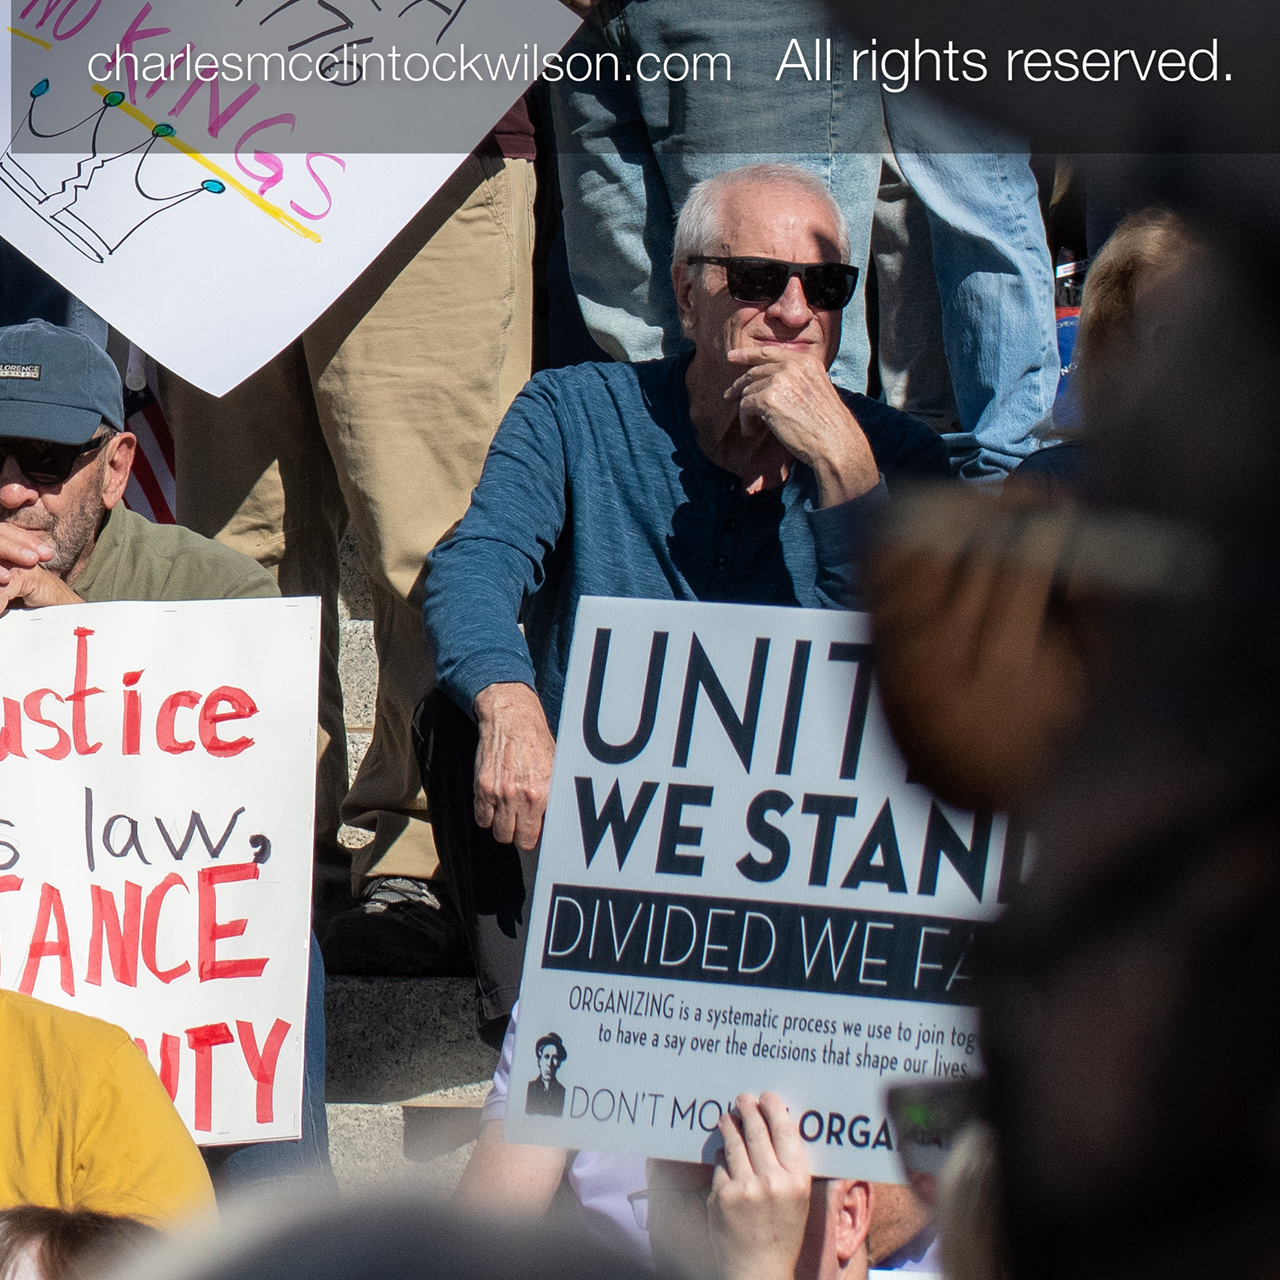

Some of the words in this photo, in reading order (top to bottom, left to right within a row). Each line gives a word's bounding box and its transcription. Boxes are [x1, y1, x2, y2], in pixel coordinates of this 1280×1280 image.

[103, 1, 346, 220] KINGS
[581, 627, 887, 782] UNIT
[84, 786, 272, 866] law,
[573, 775, 715, 878] WE
[547, 896, 777, 974] DIVIDED
[800, 916, 894, 986] WE
[914, 925, 974, 992] FA
[568, 985, 675, 1020] ORGANIZING
[678, 1001, 690, 1021] is
[694, 1009, 702, 1022] a
[707, 1004, 779, 1031] systematic
[783, 1014, 838, 1036] process
[842, 1021, 862, 1037] we
[867, 1023, 892, 1040] use
[897, 1023, 912, 1042] to
[915, 1024, 945, 1050] join
[598, 1022, 612, 1042] to
[616, 1022, 647, 1046] have
[652, 1034, 659, 1048] a
[664, 1034, 686, 1056] say
[690, 1037, 721, 1053] over
[725, 1031, 747, 1056] the
[752, 1032, 817, 1063] decisions
[822, 1038, 850, 1066] that
[855, 1043, 898, 1076] shape
[903, 1056, 928, 1073] our
[569, 1086, 665, 1127] DON'T
[799, 1108, 895, 1151] ORGA
